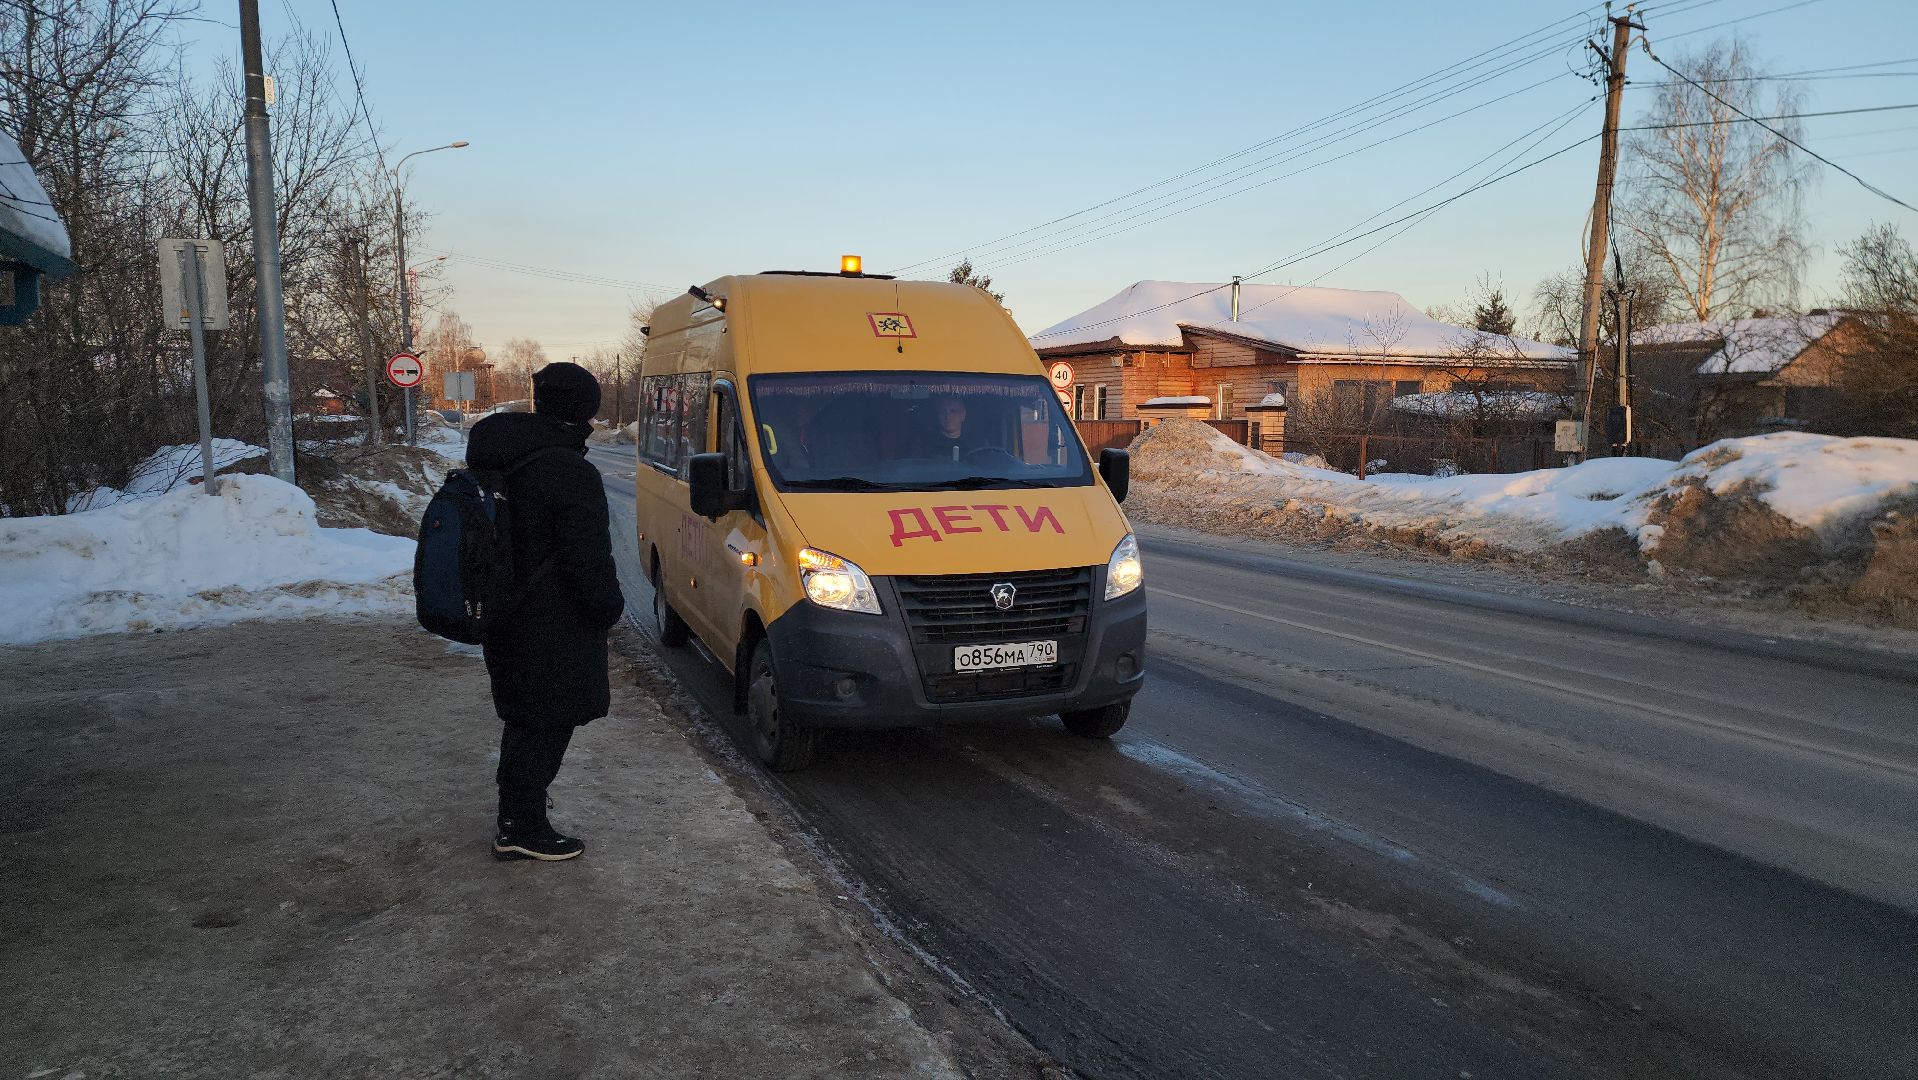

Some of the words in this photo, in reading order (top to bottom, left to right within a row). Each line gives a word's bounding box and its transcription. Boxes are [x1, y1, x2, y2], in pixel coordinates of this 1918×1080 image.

[1055, 370, 1068, 380] 40
[887, 504, 1066, 548] ДЕТИ
[1029, 642, 1053, 658] 790
